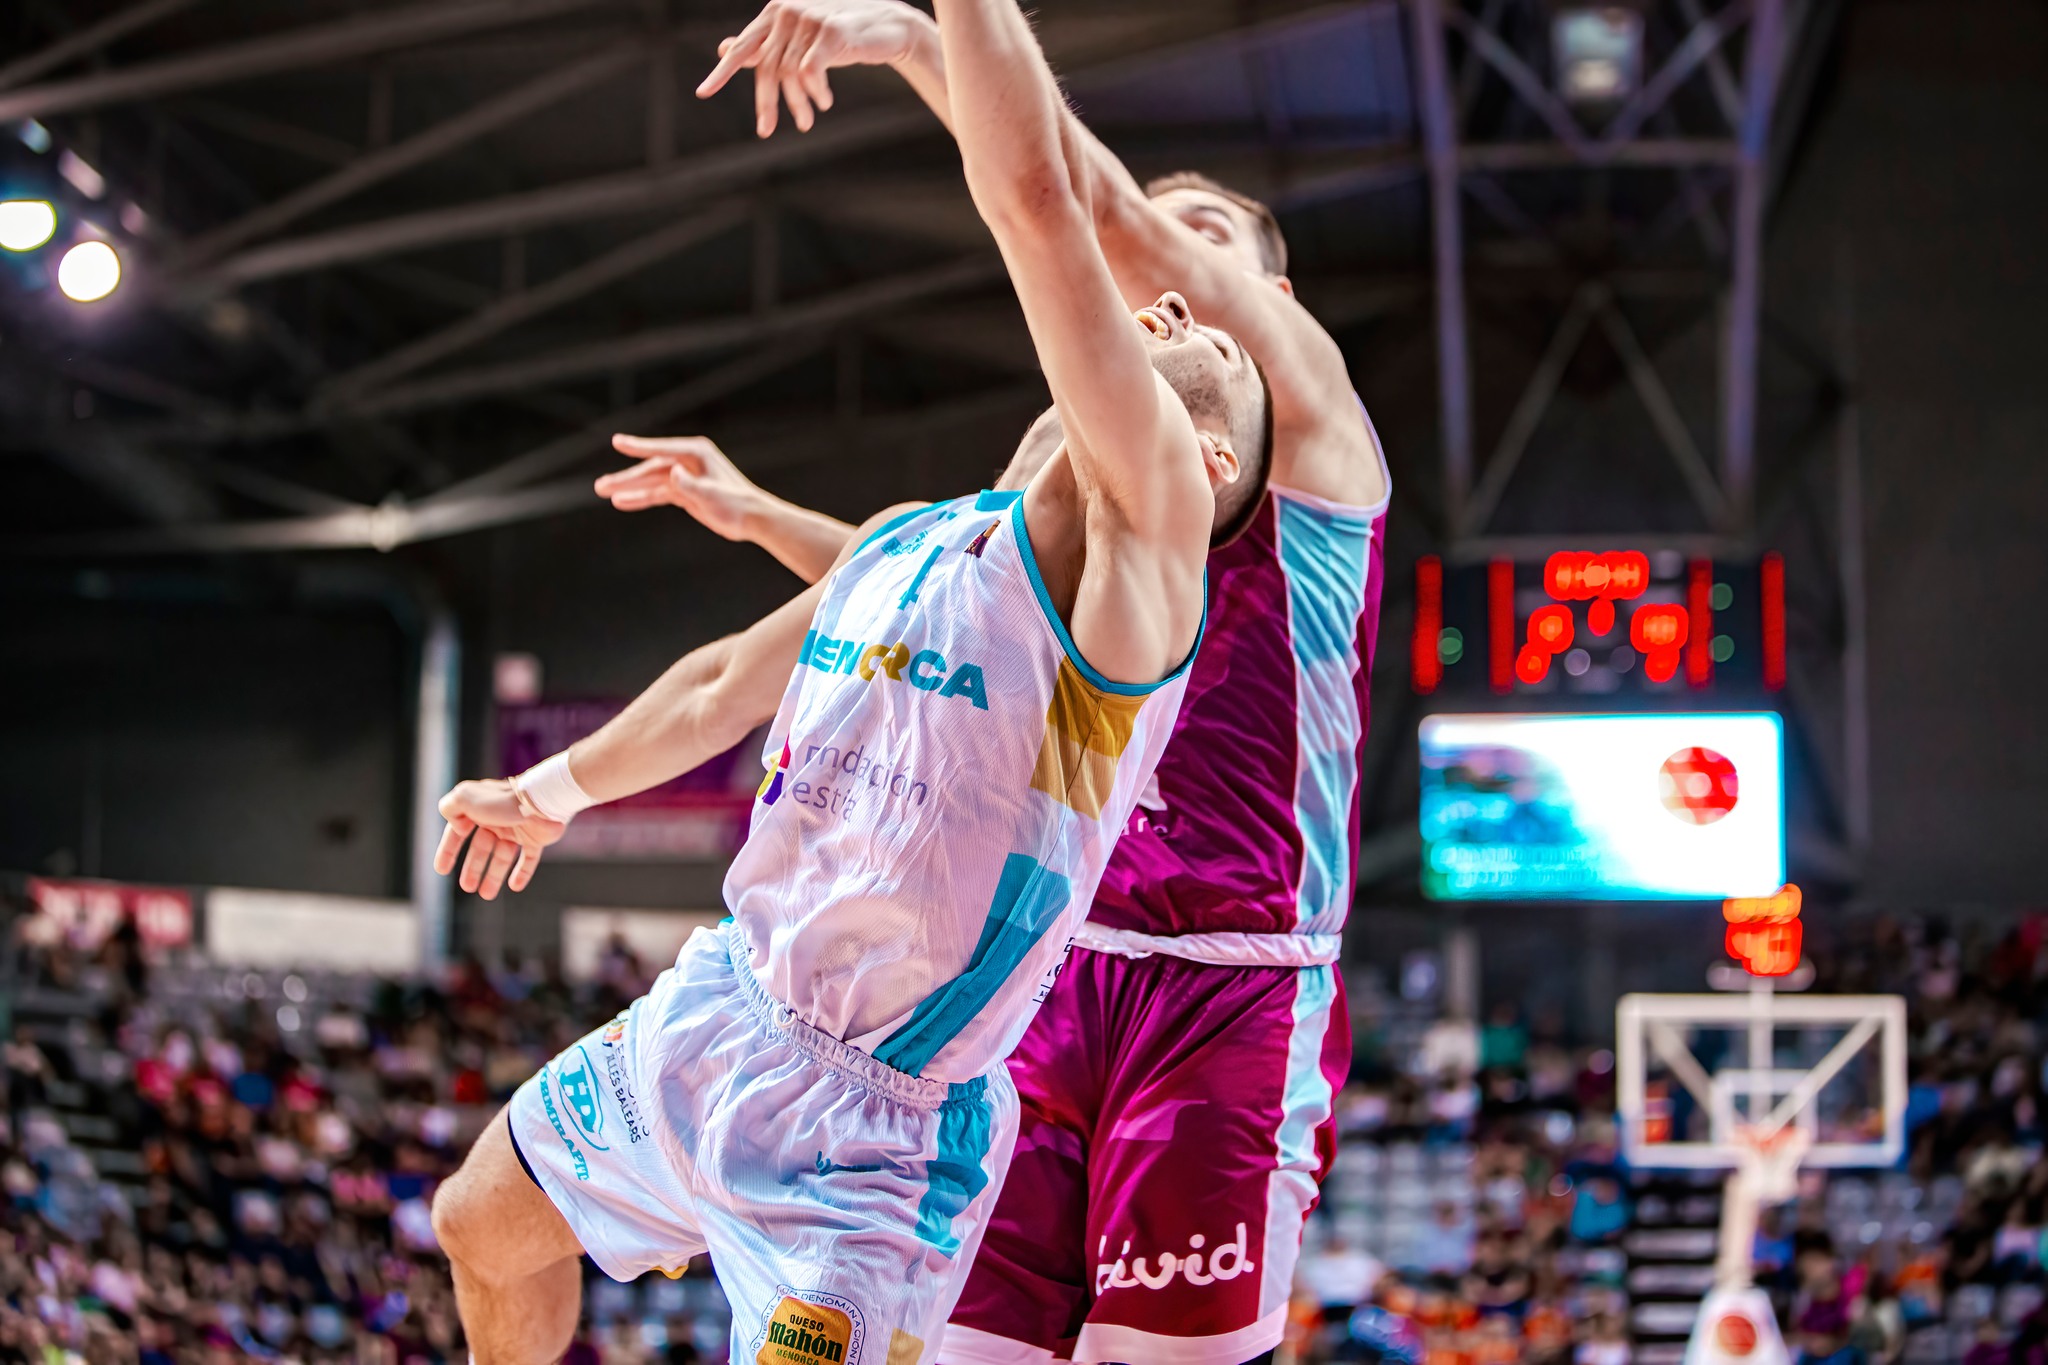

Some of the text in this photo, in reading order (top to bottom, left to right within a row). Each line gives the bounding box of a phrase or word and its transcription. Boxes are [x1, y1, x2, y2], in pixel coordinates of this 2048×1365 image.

[784, 781, 857, 823] estia
[615, 1087, 642, 1144] BALEARS
[789, 1314, 825, 1332] QUESO
[776, 1348, 819, 1365] MENORCA
